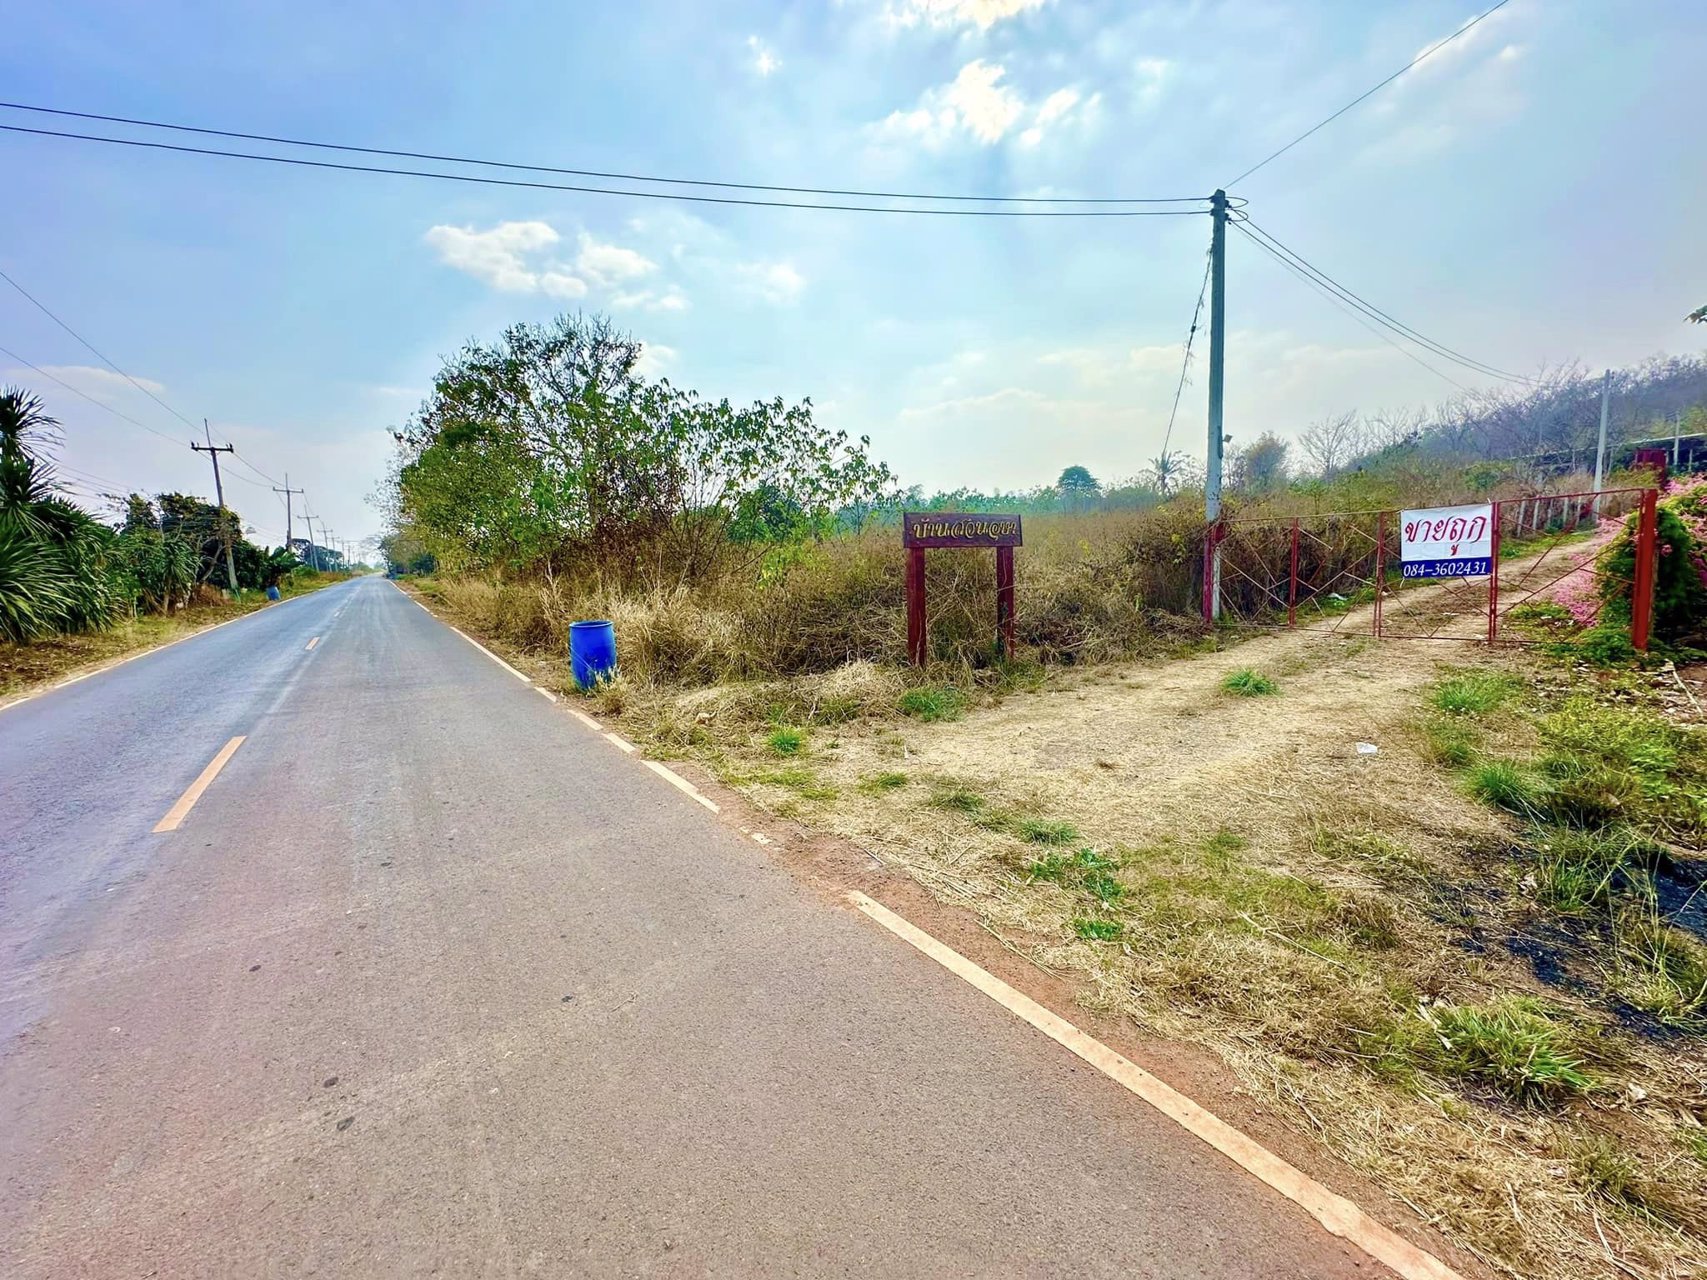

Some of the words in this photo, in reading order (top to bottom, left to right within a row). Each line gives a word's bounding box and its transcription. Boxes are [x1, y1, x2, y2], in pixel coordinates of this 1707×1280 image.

[1404, 515, 1488, 557] ขายถูก
[1403, 561, 1487, 578] 084-3602431
